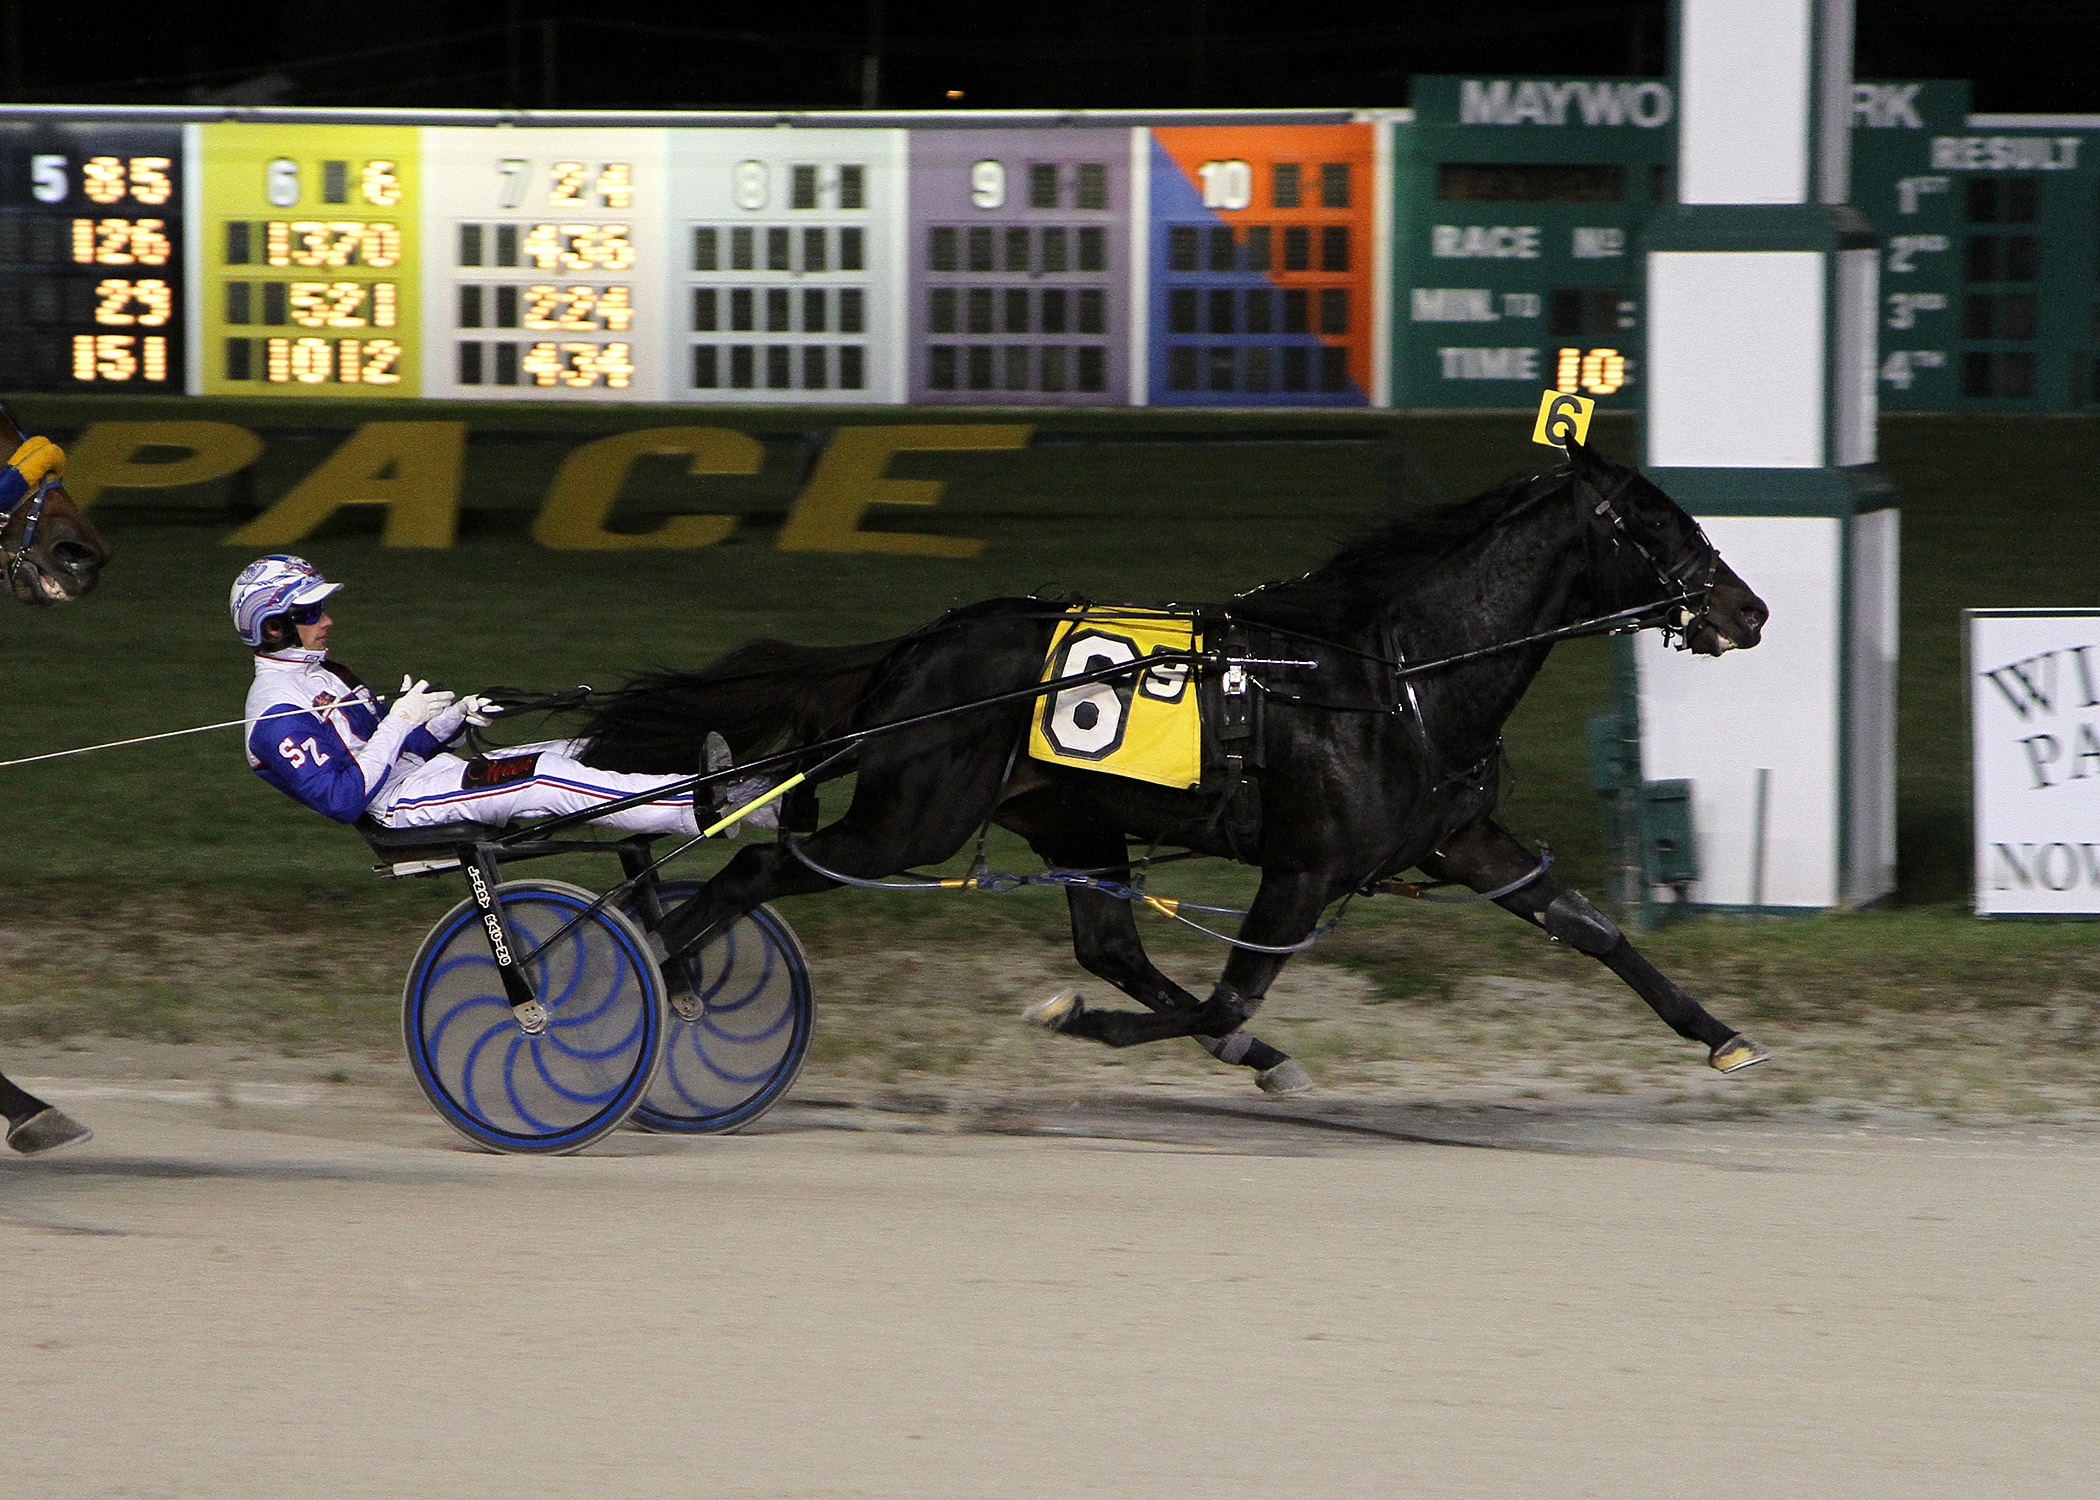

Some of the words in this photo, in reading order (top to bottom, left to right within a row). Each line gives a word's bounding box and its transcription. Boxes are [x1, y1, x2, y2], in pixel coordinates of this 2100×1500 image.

[1932, 136, 2082, 170] RESULT
[31, 155, 69, 202] 5
[84, 157, 171, 203] 85
[267, 158, 299, 206] 6
[361, 161, 401, 205] 6
[496, 158, 531, 208] 7
[550, 162, 635, 207] 24
[971, 160, 1004, 209] 9
[1198, 160, 1252, 210] 10
[72, 218, 171, 264] 126
[268, 222, 401, 266] 1370
[1432, 225, 1542, 257] RACE
[95, 279, 171, 326] 29
[290, 282, 397, 327] 521
[523, 286, 635, 331] 224
[73, 335, 166, 381] 151
[268, 338, 401, 384] 1012
[523, 343, 635, 388] 434
[1438, 348, 1541, 379] TIME
[1545, 394, 1583, 446] 6
[64, 419, 1036, 558] PACE
[1043, 629, 1141, 760] 6
[467, 865, 491, 909] LINDY
[484, 914, 512, 967] RACING
